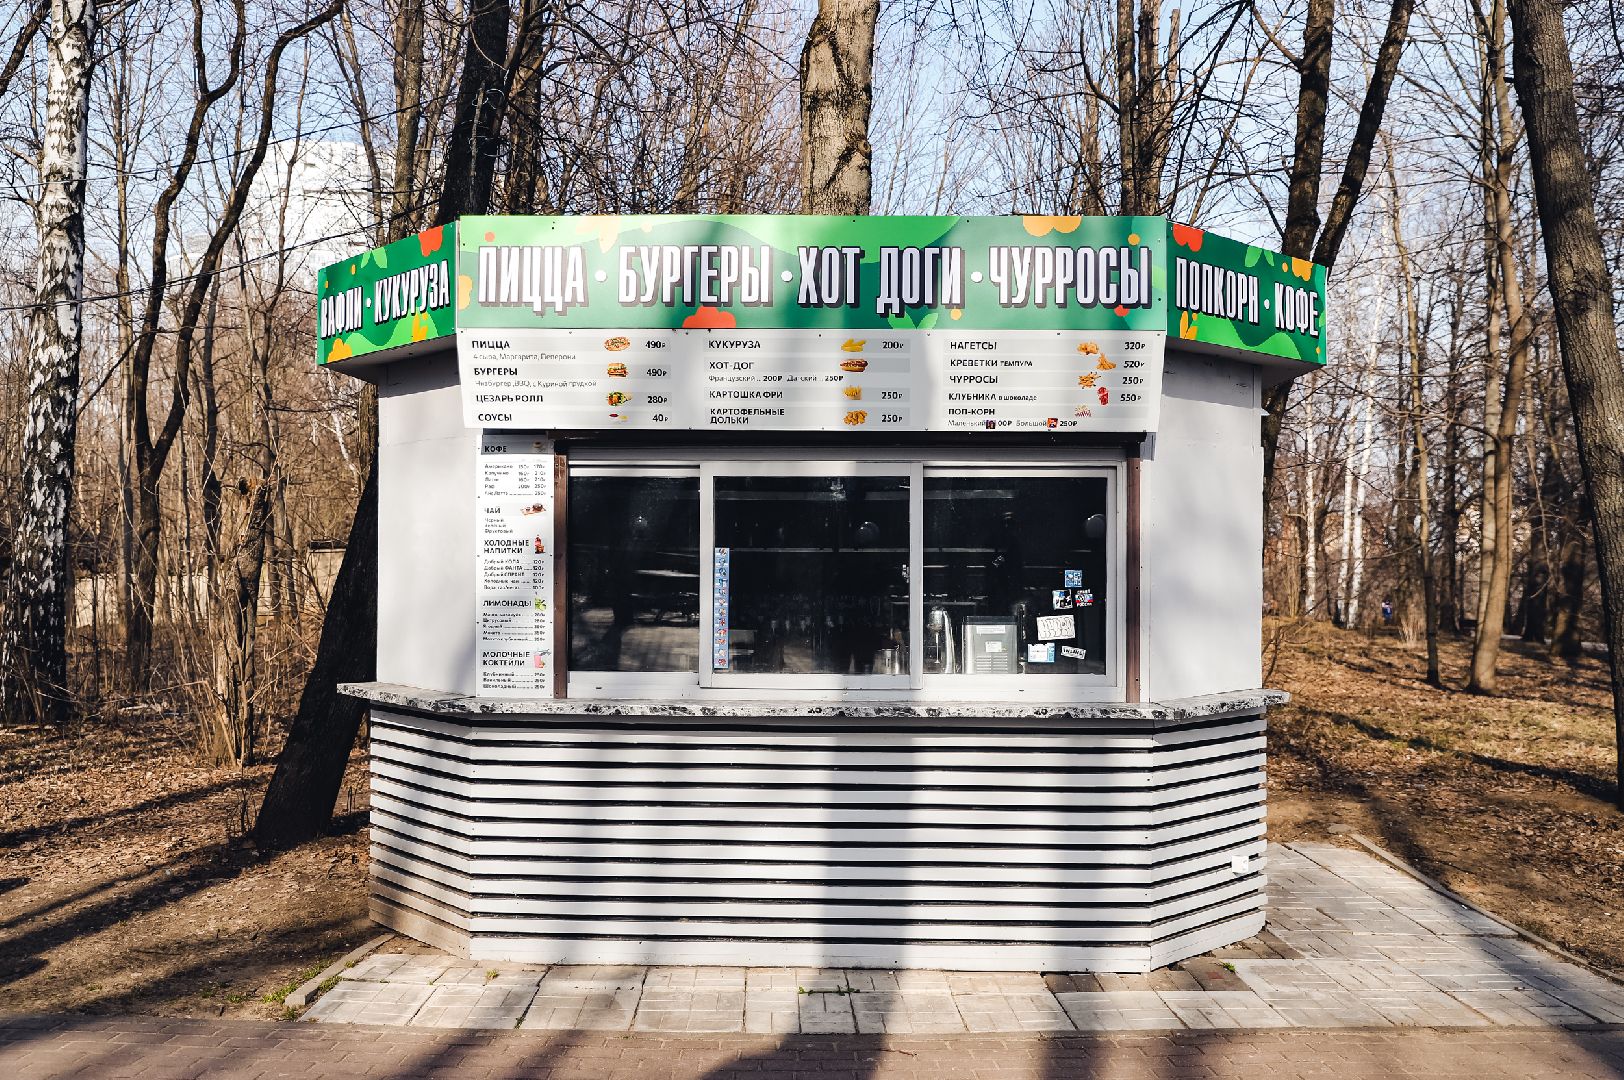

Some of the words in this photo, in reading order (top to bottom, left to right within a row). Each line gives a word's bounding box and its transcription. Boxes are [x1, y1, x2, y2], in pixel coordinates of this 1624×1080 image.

[478, 246, 588, 315] ПИЦЦА
[618, 246, 773, 306] БУРГЕРЫ
[798, 247, 864, 307] ХОТ
[876, 247, 965, 317] ДОГИ
[988, 247, 1151, 308] ЧУРРОСЫ
[320, 286, 363, 339] ВАФЛИ
[374, 259, 450, 325] КУКУРУЗА
[1176, 257, 1259, 325] ПОПКОРН
[1274, 282, 1319, 337] КОФЕ
[472, 340, 510, 349] ПИЦЦА
[708, 340, 761, 349] КУКУРУЗА
[950, 342, 997, 350] НАГЕТСЫ
[709, 361, 754, 370] ХОТ-ДОГ
[950, 359, 998, 367] КРЕВЕТКИ
[474, 368, 518, 376] БУРГЕРЫ
[949, 375, 998, 384] ЧУРРОСЫ
[709, 391, 761, 399] КАРТОШКА
[763, 391, 783, 399] ФРИ
[948, 393, 997, 401] КЛУБНИКА
[1003, 394, 1037, 402] шоколаде
[476, 395, 514, 404] ЦЕЗАРЬ
[710, 408, 785, 416] КАРТОФЕЛЬНЫЕ
[948, 408, 995, 416] ПОП-КОРН
[478, 413, 512, 421] СОУСЫ
[710, 416, 749, 424] ДОЛЬКИ
[484, 505, 501, 514] ЧАЙ
[484, 539, 530, 547] ХОЛОДНЫЕ
[483, 658, 525, 666] КОКТЕЙЛИ
